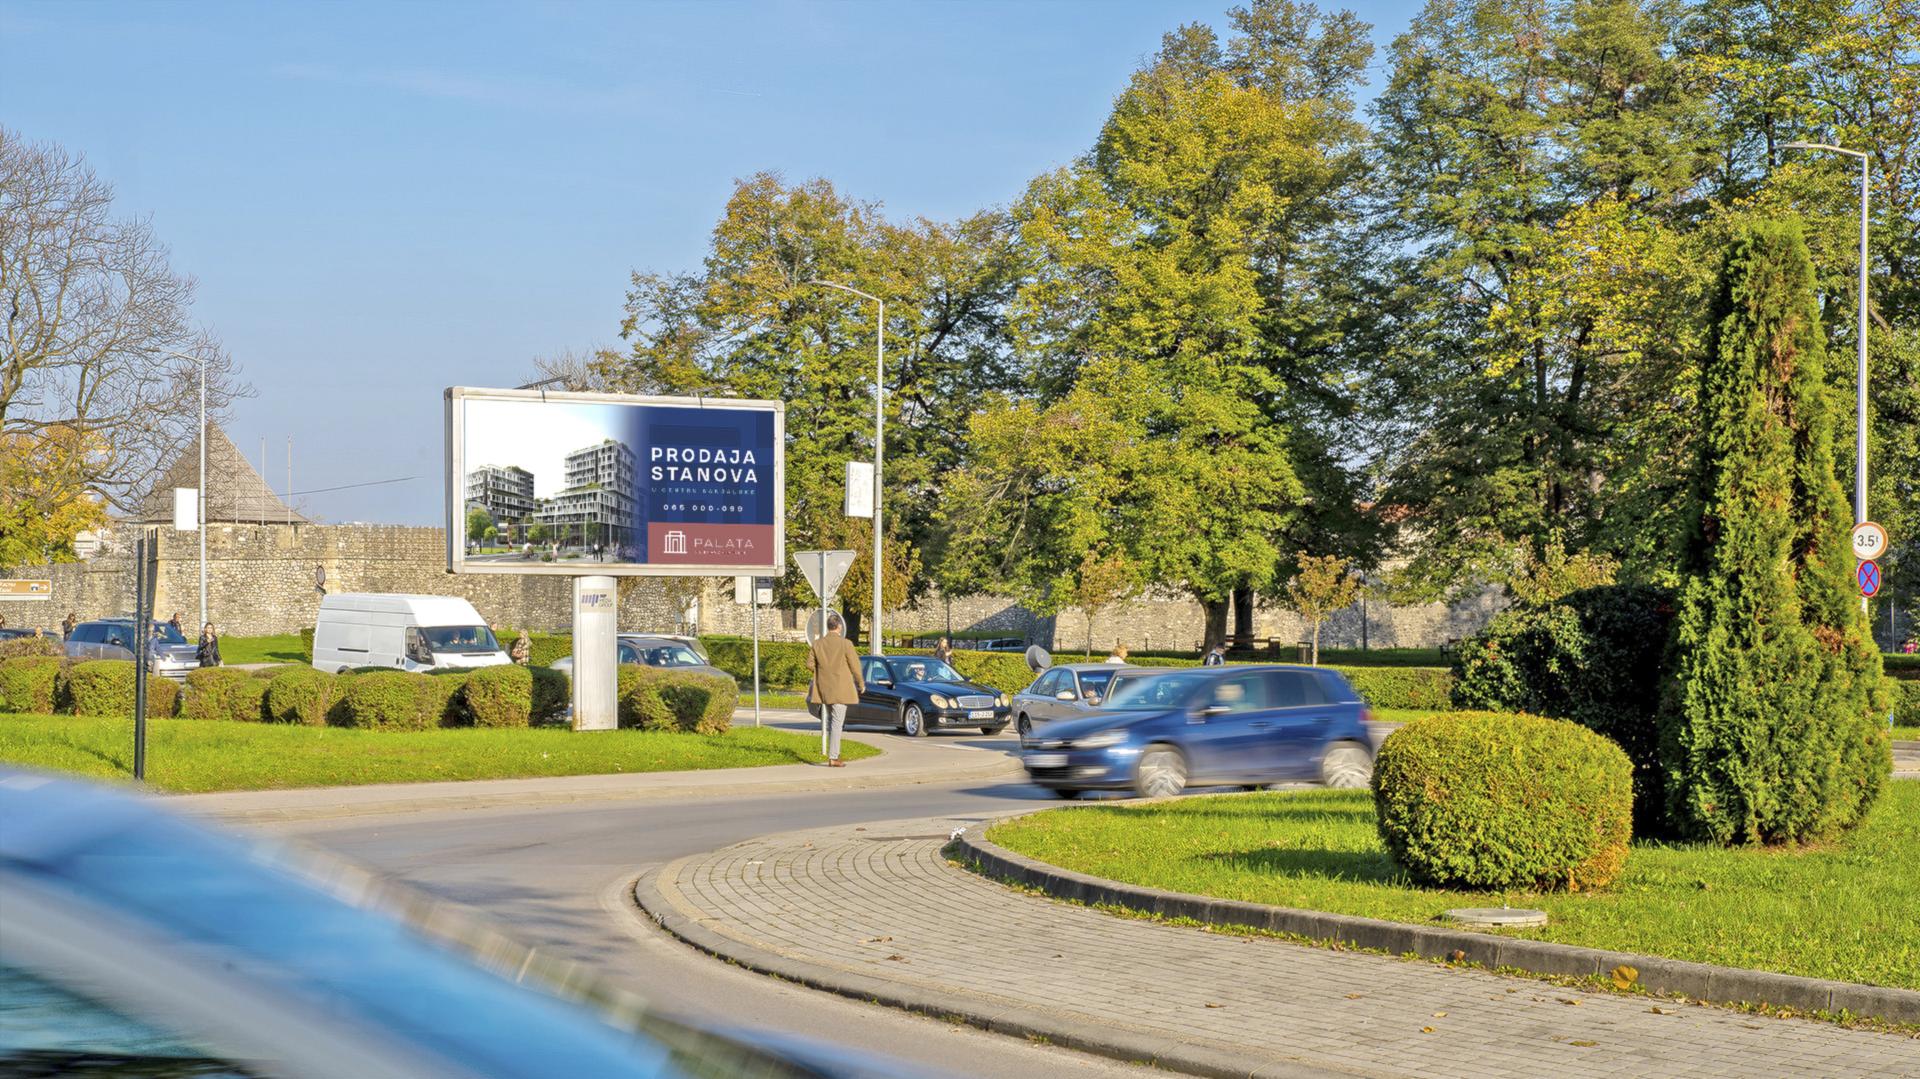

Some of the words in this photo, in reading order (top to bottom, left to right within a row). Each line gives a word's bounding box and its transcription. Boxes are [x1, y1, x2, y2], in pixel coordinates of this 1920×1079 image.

[651, 447, 756, 464] PRODAJA
[651, 466, 758, 483] STANOVA
[693, 538, 755, 549] PALATA
